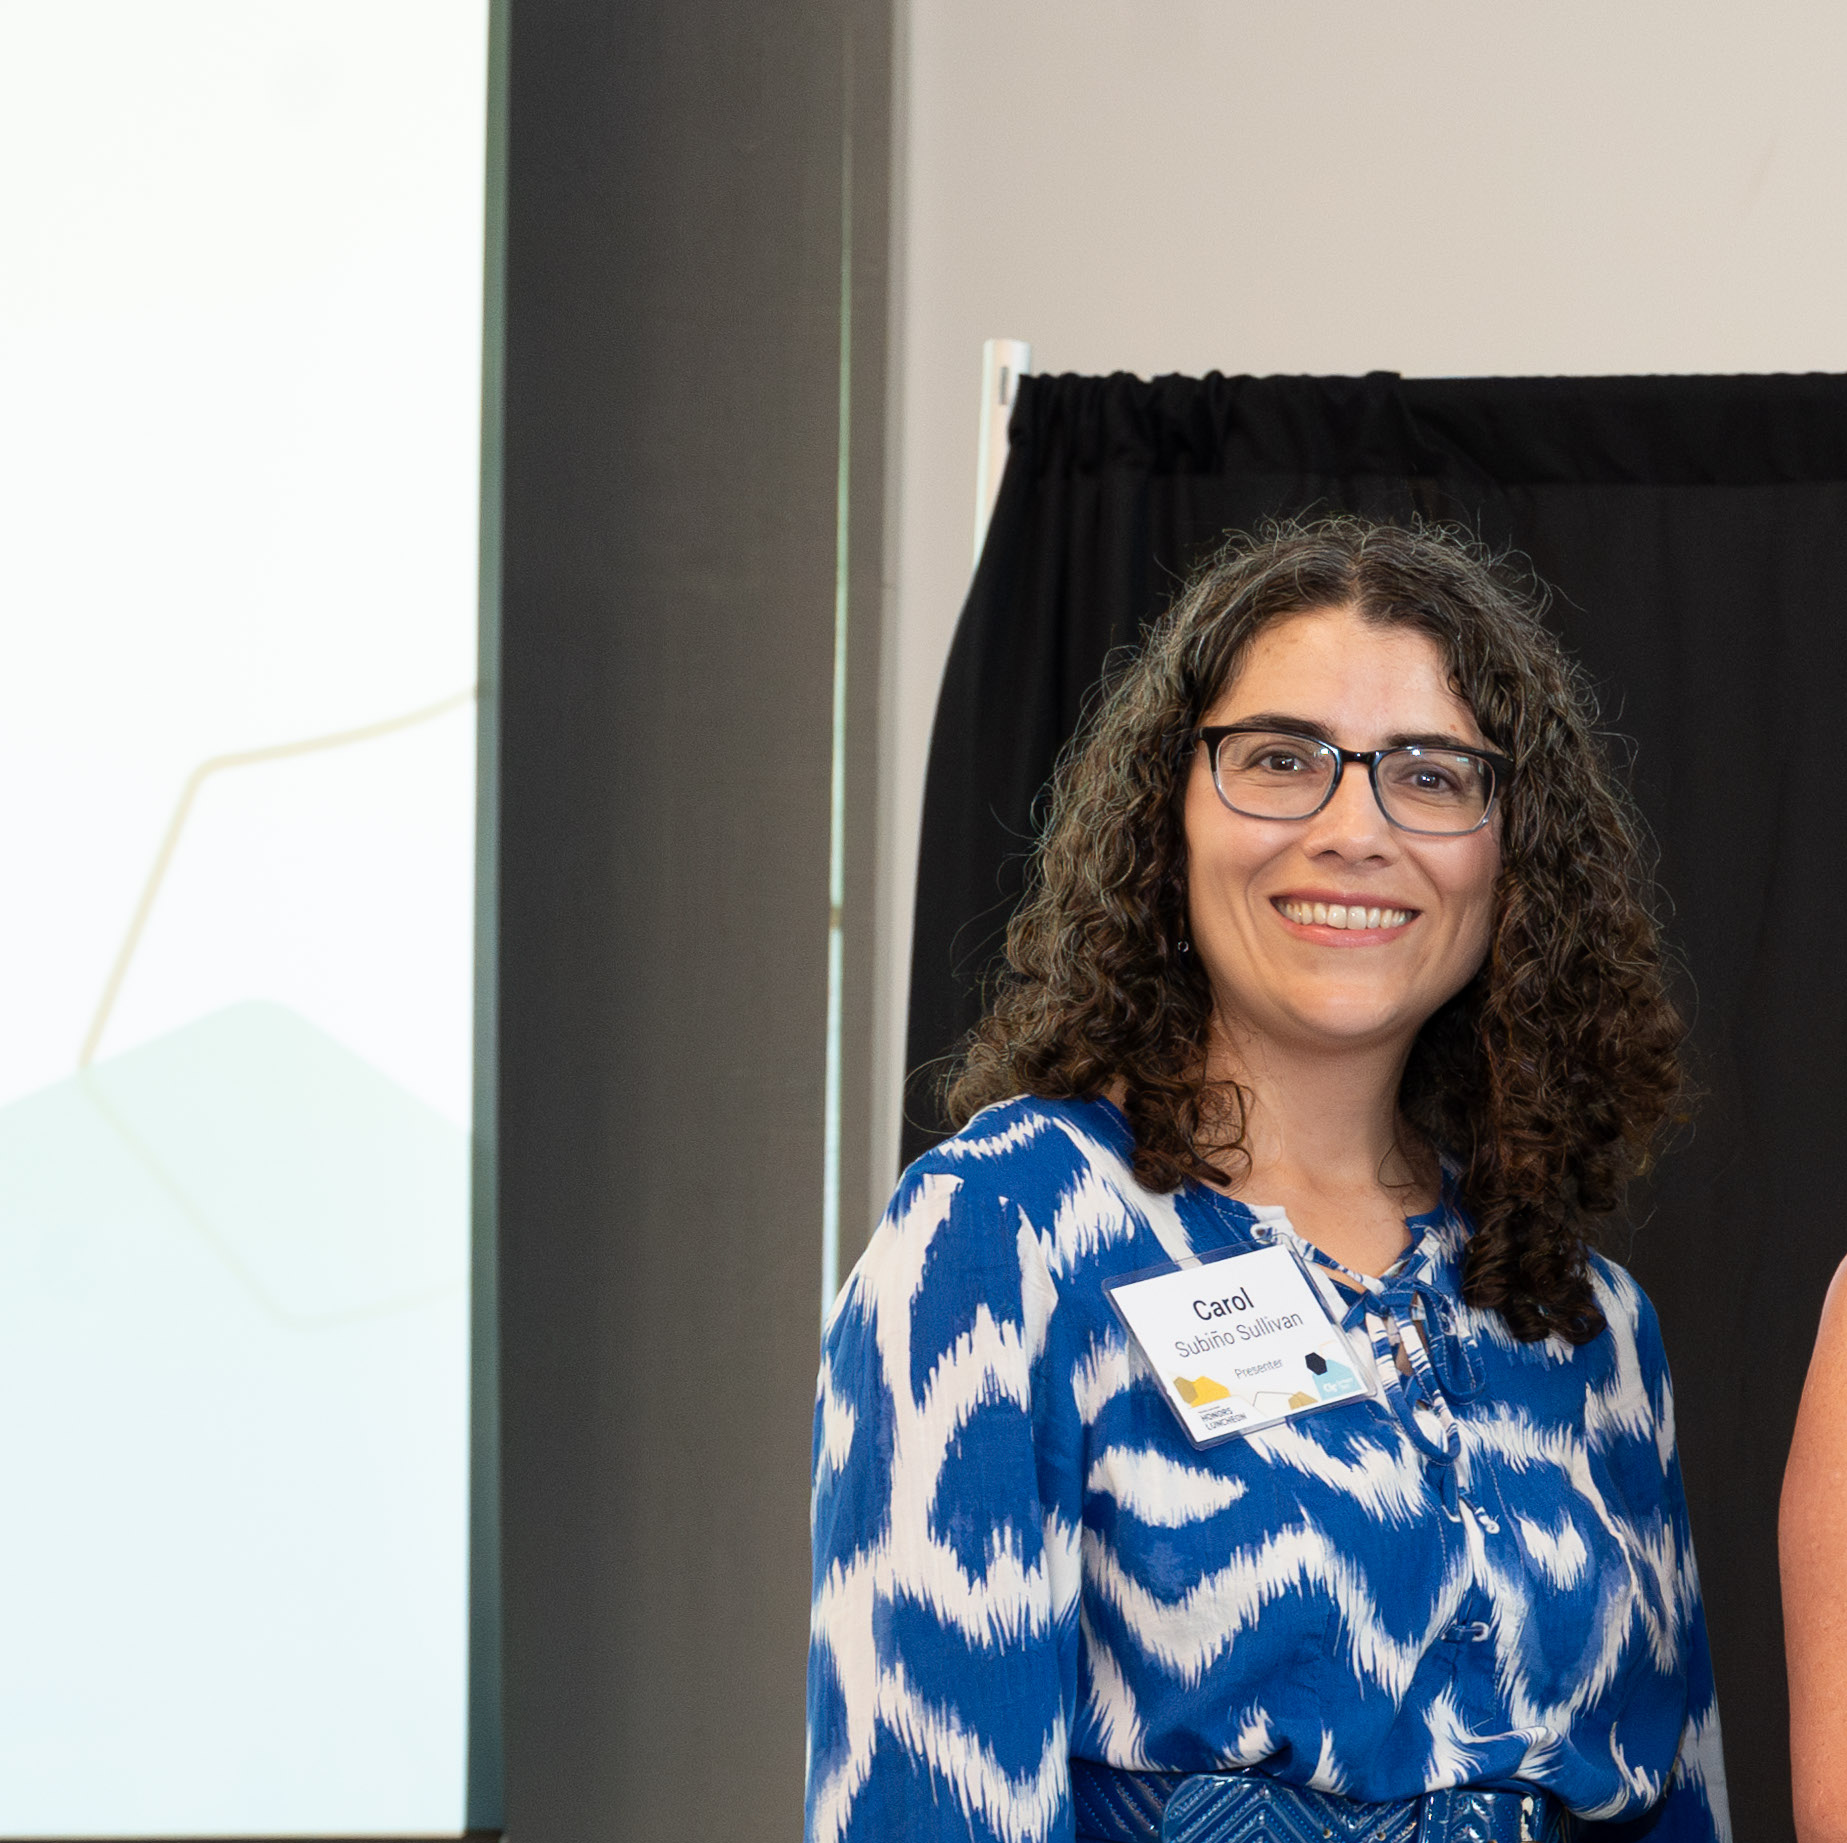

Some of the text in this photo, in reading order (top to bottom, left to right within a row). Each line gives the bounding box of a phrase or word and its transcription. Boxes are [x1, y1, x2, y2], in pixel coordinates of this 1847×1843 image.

[1193, 1287, 1254, 1321] Carol
[1175, 1313, 1304, 1358] Subiño Sullivan
[1234, 1359, 1283, 1379] Presenter
[1200, 1407, 1234, 1422] HONORS
[1204, 1413, 1247, 1431] LUNCHEON
